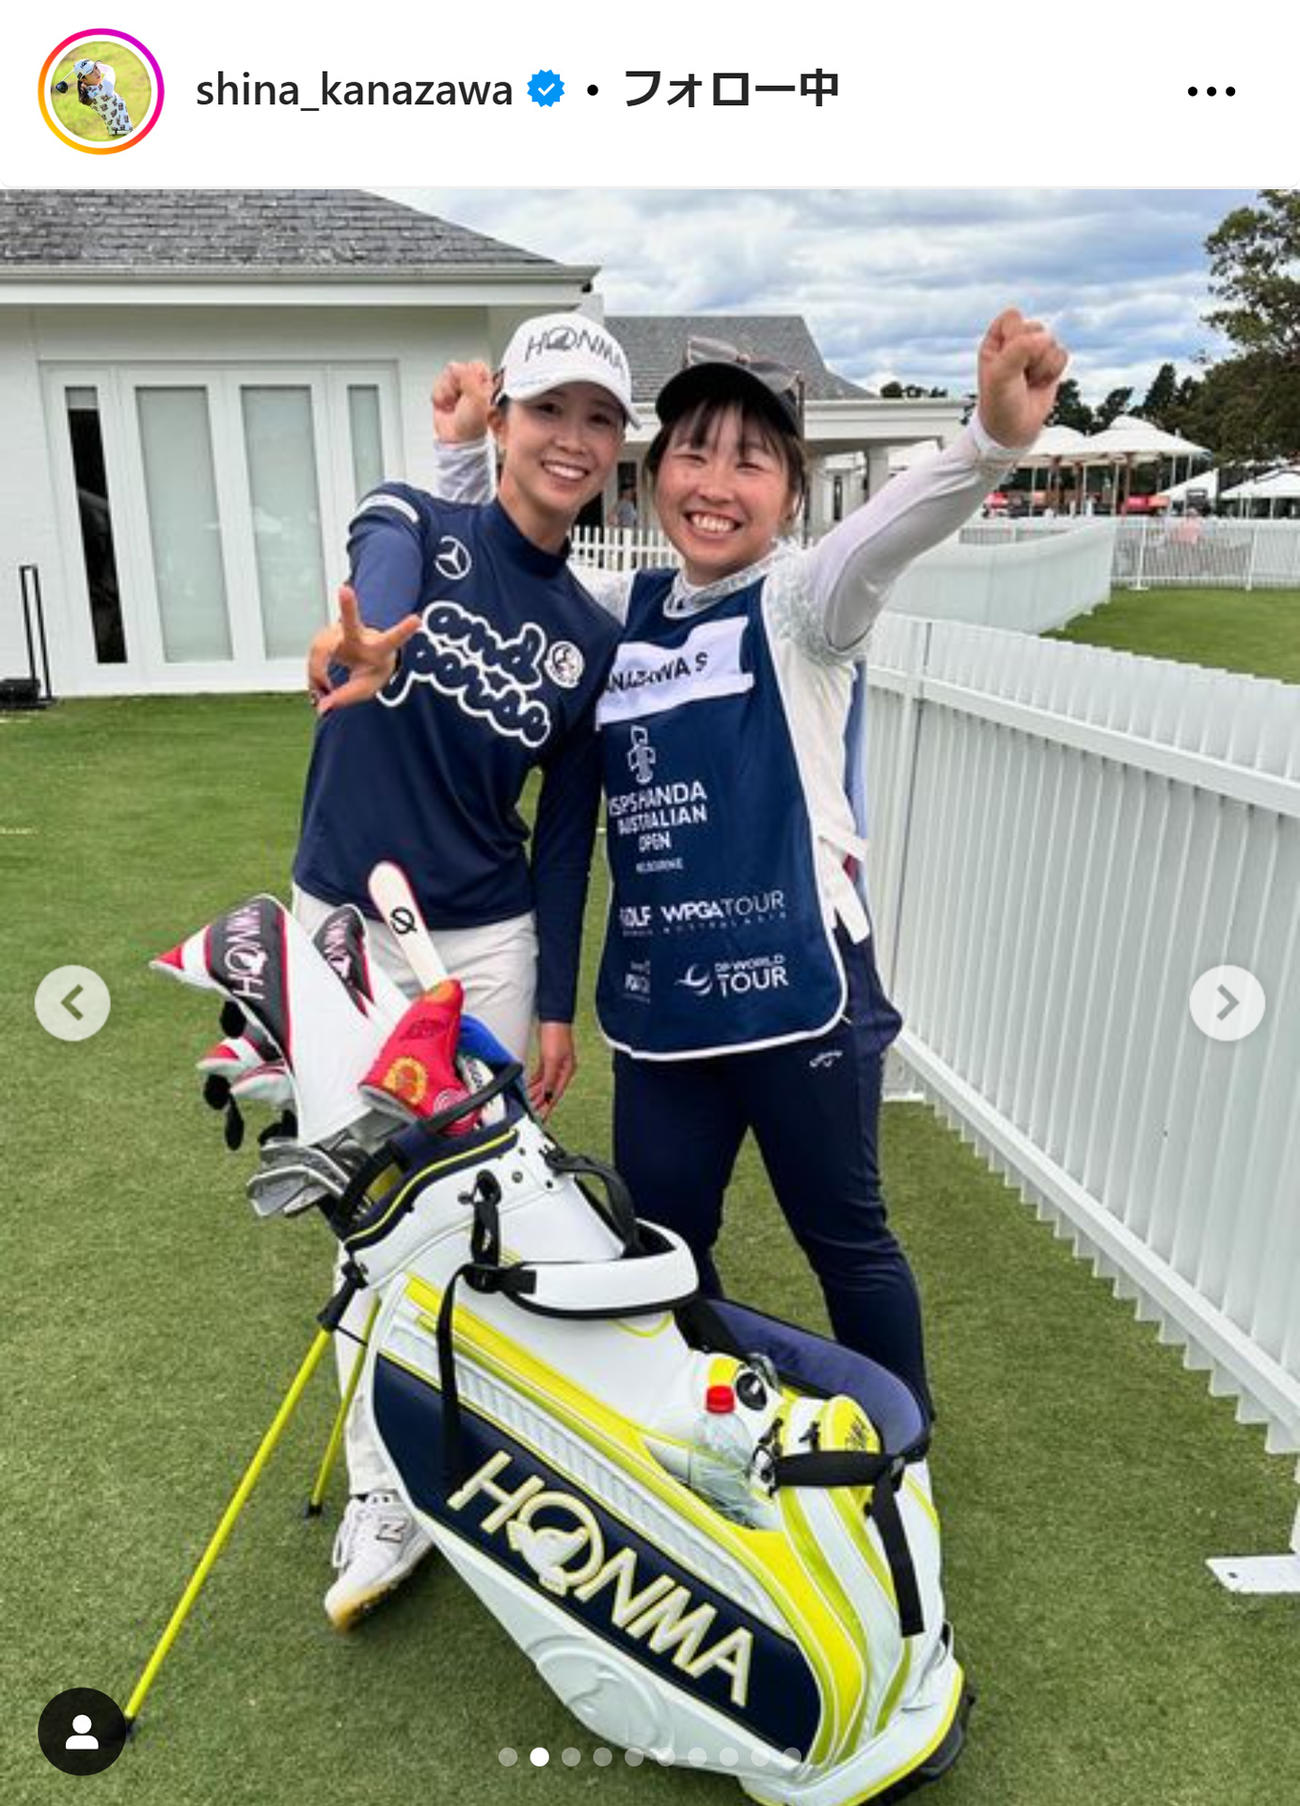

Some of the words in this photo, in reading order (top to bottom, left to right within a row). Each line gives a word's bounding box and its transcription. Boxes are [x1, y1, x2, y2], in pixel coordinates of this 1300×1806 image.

[695, 651, 708, 672] S
[717, 966, 789, 998] TOUR
[446, 1450, 754, 1708] HONMA
